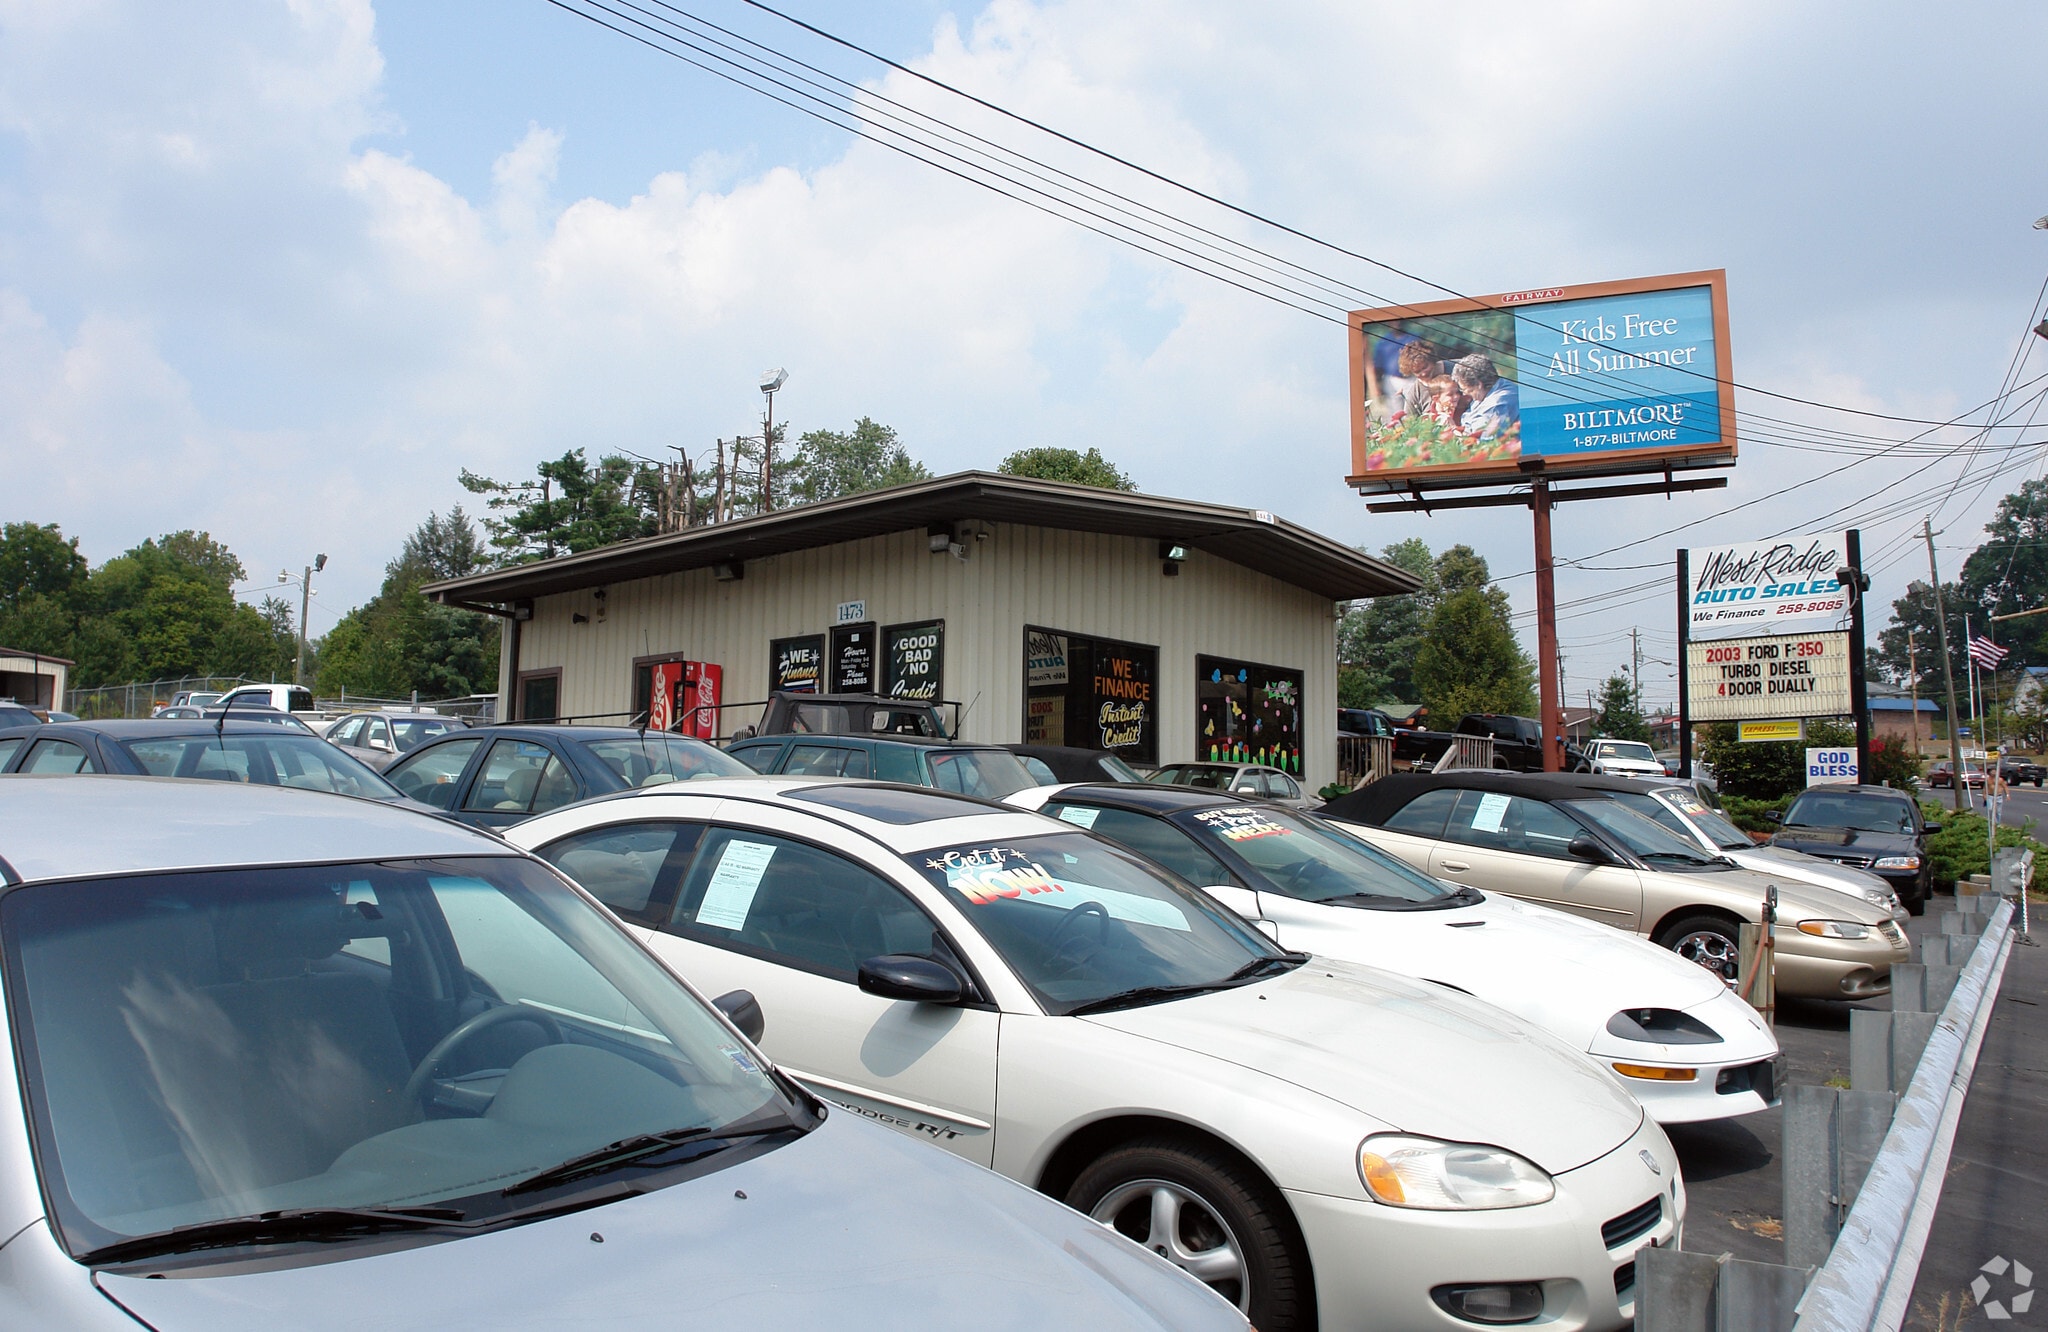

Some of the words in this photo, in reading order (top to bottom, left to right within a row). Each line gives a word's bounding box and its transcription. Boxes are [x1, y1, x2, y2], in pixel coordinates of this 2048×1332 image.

[1505, 289, 1560, 302] FAIRWAY
[1560, 316, 1616, 346] Kids
[1622, 313, 1678, 339] Free
[1546, 349, 1580, 377] All
[1587, 344, 1696, 373] Summer
[1572, 428, 1677, 448] 1-877-BILTMORE
[1696, 549, 1758, 592] West
[1754, 539, 1836, 584] Ridge
[1693, 586, 1758, 605] AUTO
[1760, 579, 1842, 600] SALES
[839, 603, 863, 621] 1473
[1693, 611, 1713, 622] We
[1716, 607, 1765, 620] Finance
[1776, 600, 1844, 615] 258-8085
[844, 646, 867, 658] Hours
[899, 635, 937, 650] GOOD
[1706, 647, 1741, 663] 2003
[1748, 643, 1779, 660] FORD
[1785, 641, 1824, 658] F-350
[790, 649, 810, 664] WE
[905, 649, 932, 663] BAD
[778, 660, 818, 684] Finance
[846, 670, 864, 679] Phone
[909, 662, 929, 675] NO
[1111, 658, 1132, 678] WE
[1720, 663, 1761, 679] TURBO
[1769, 660, 1811, 676] DIESEL
[891, 679, 937, 699] Credit
[1094, 676, 1150, 701] FINANCE
[1718, 682, 1726, 697] 4
[1729, 680, 1762, 696] DOOR
[1767, 677, 1816, 694] DUALLY
[1100, 702, 1144, 723] Instant
[1104, 725, 1140, 747] Credit
[1744, 725, 1776, 733] EXPRESS
[1817, 752, 1850, 764] GOD
[1809, 765, 1858, 777] BLESS
[939, 849, 986, 875] Get
[991, 847, 1008, 863] it
[950, 863, 1065, 905] NOW!
[915, 1121, 964, 1140] R/T
